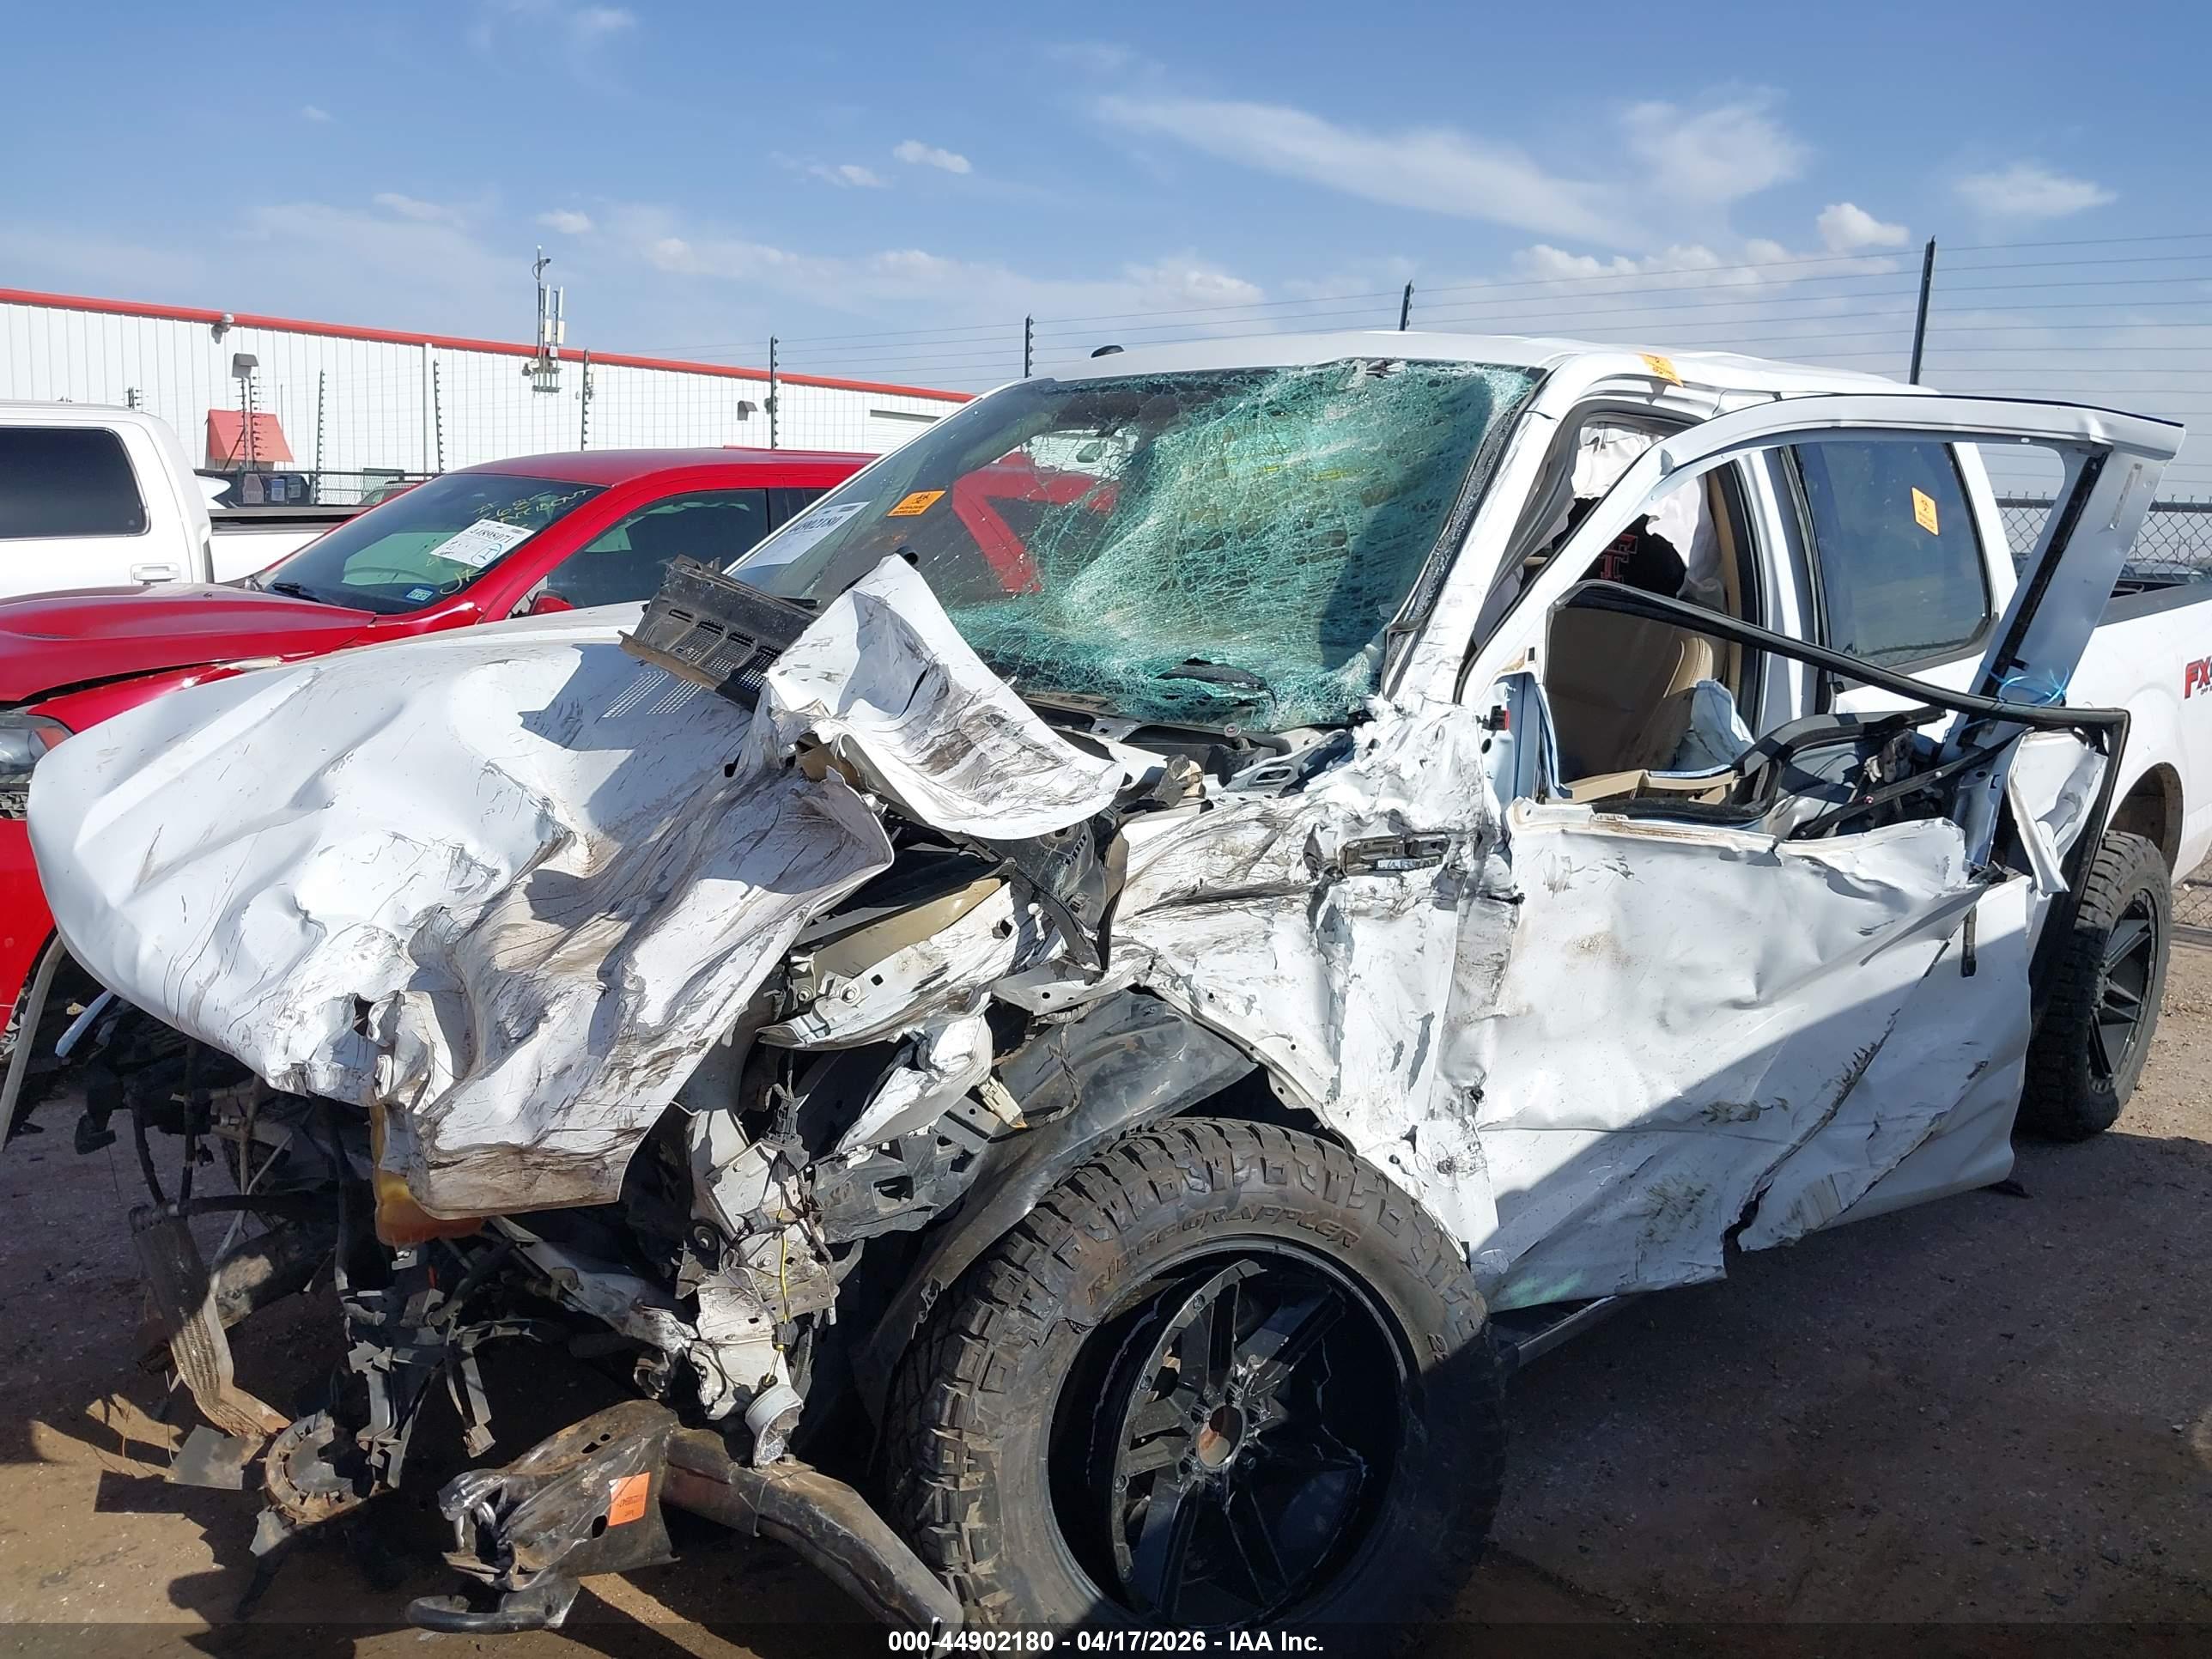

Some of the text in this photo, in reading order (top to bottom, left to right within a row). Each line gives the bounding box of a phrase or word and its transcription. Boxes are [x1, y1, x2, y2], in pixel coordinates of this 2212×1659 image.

[2184, 655, 2212, 700] FX
[1376, 856, 1441, 870] LARIAT
[1182, 1205, 1360, 1249] GRAPPLER
